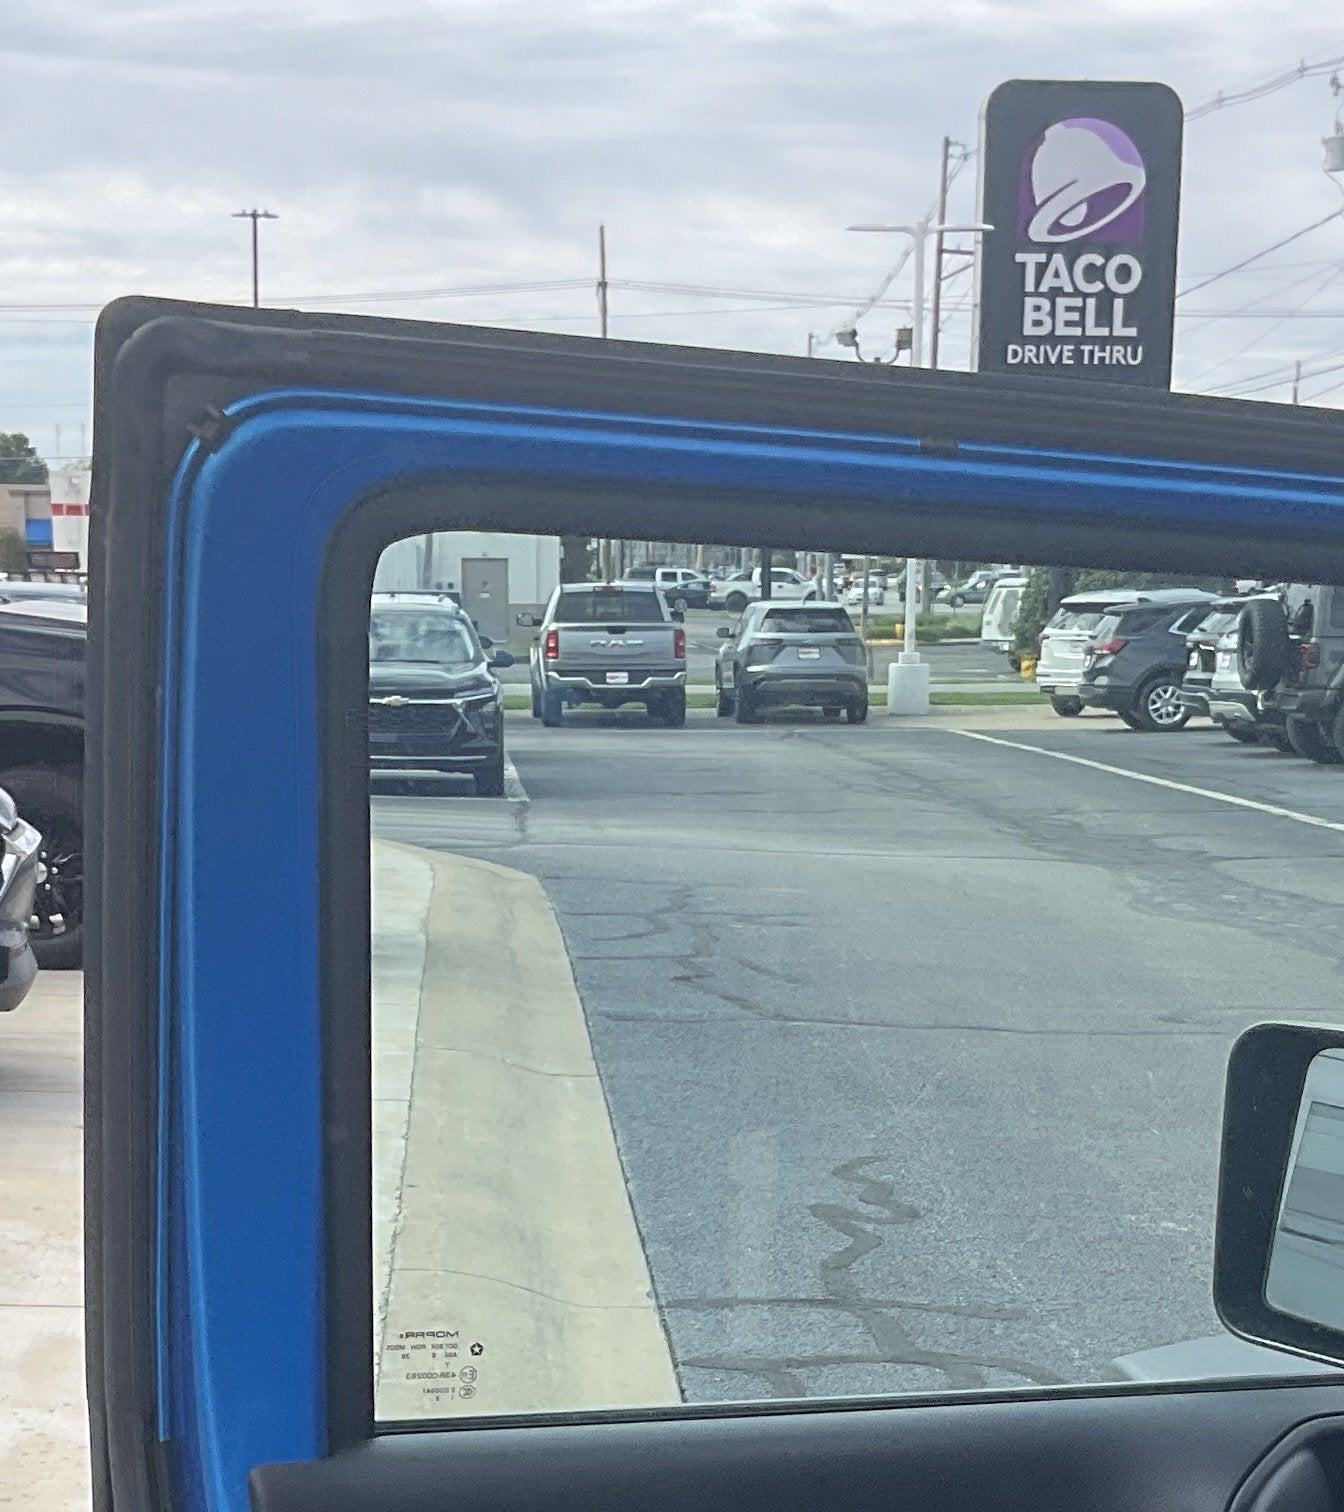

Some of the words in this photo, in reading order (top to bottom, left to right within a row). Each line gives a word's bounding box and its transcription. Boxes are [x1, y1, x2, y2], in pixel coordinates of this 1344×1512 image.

[1014, 252, 1143, 295] TACO
[1022, 296, 1139, 338] BELL
[1006, 344, 1075, 366] DRIVE
[1082, 344, 1144, 366] THRU
